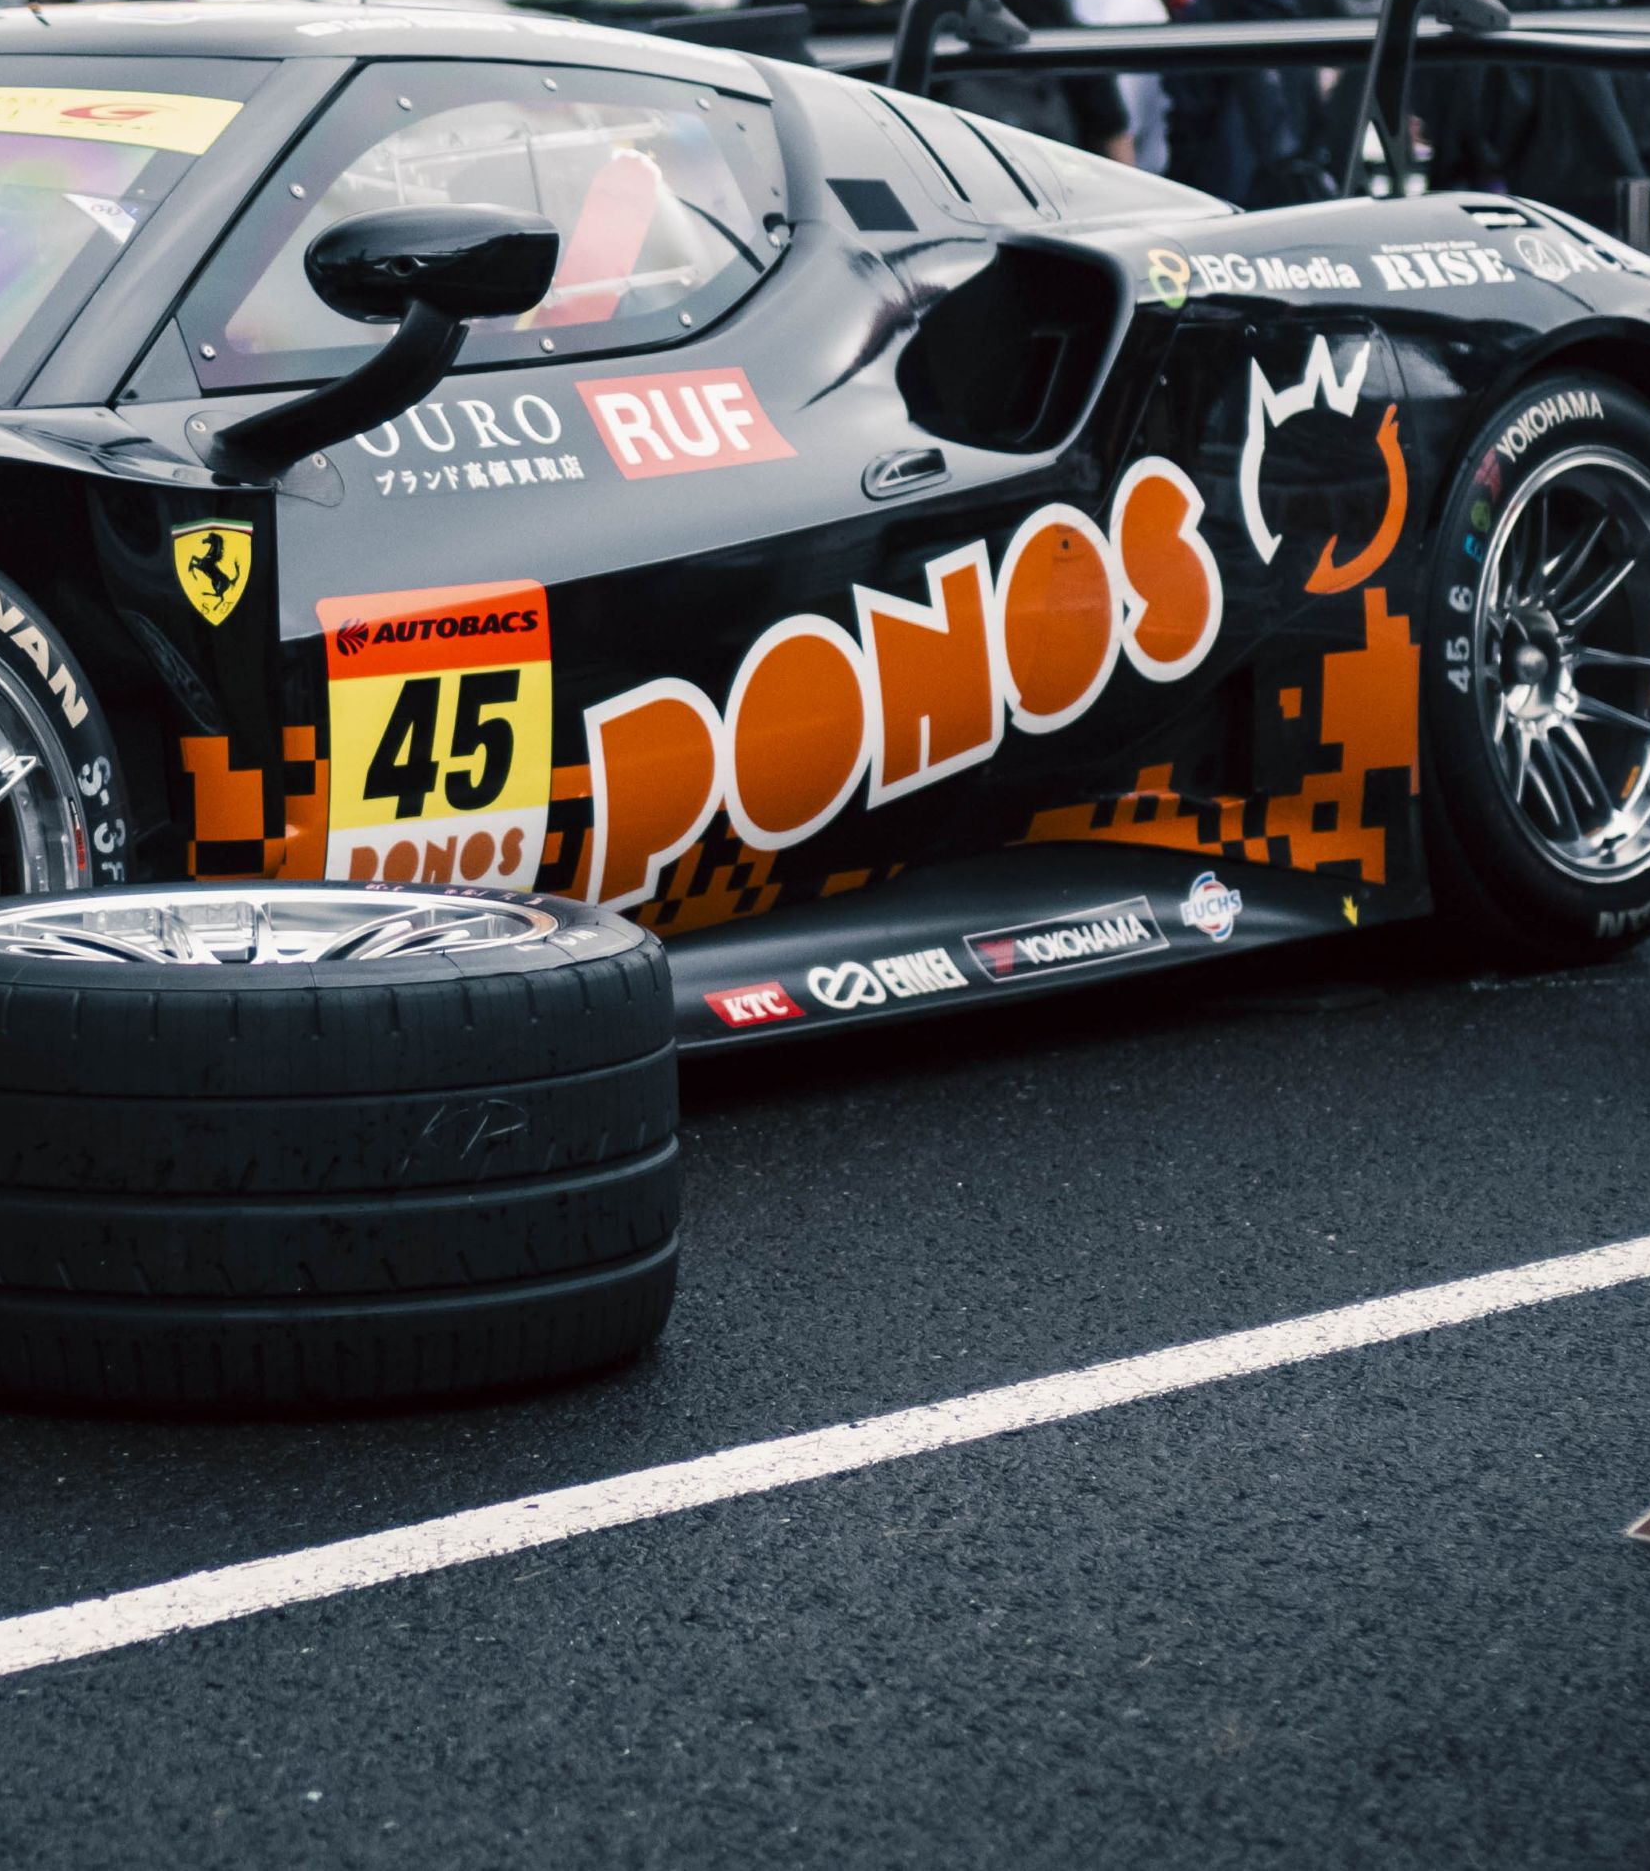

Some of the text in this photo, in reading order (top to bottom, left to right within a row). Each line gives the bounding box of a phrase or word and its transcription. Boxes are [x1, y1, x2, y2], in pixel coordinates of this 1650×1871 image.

[1257, 256, 1361, 291] Media
[1371, 248, 1516, 291] RISE
[595, 383, 754, 465] RUF
[1496, 392, 1604, 464] YOKOHAMA
[371, 609, 538, 645] AUTOBACS
[583, 457, 1223, 907] PONOS
[362, 668, 521, 820] 45
[347, 827, 525, 884] PONOS
[1182, 893, 1241, 923] FUCHS
[1016, 913, 1152, 965] YOKOHAMA
[873, 946, 969, 999] ENKEI
[723, 989, 789, 1022] KTC
